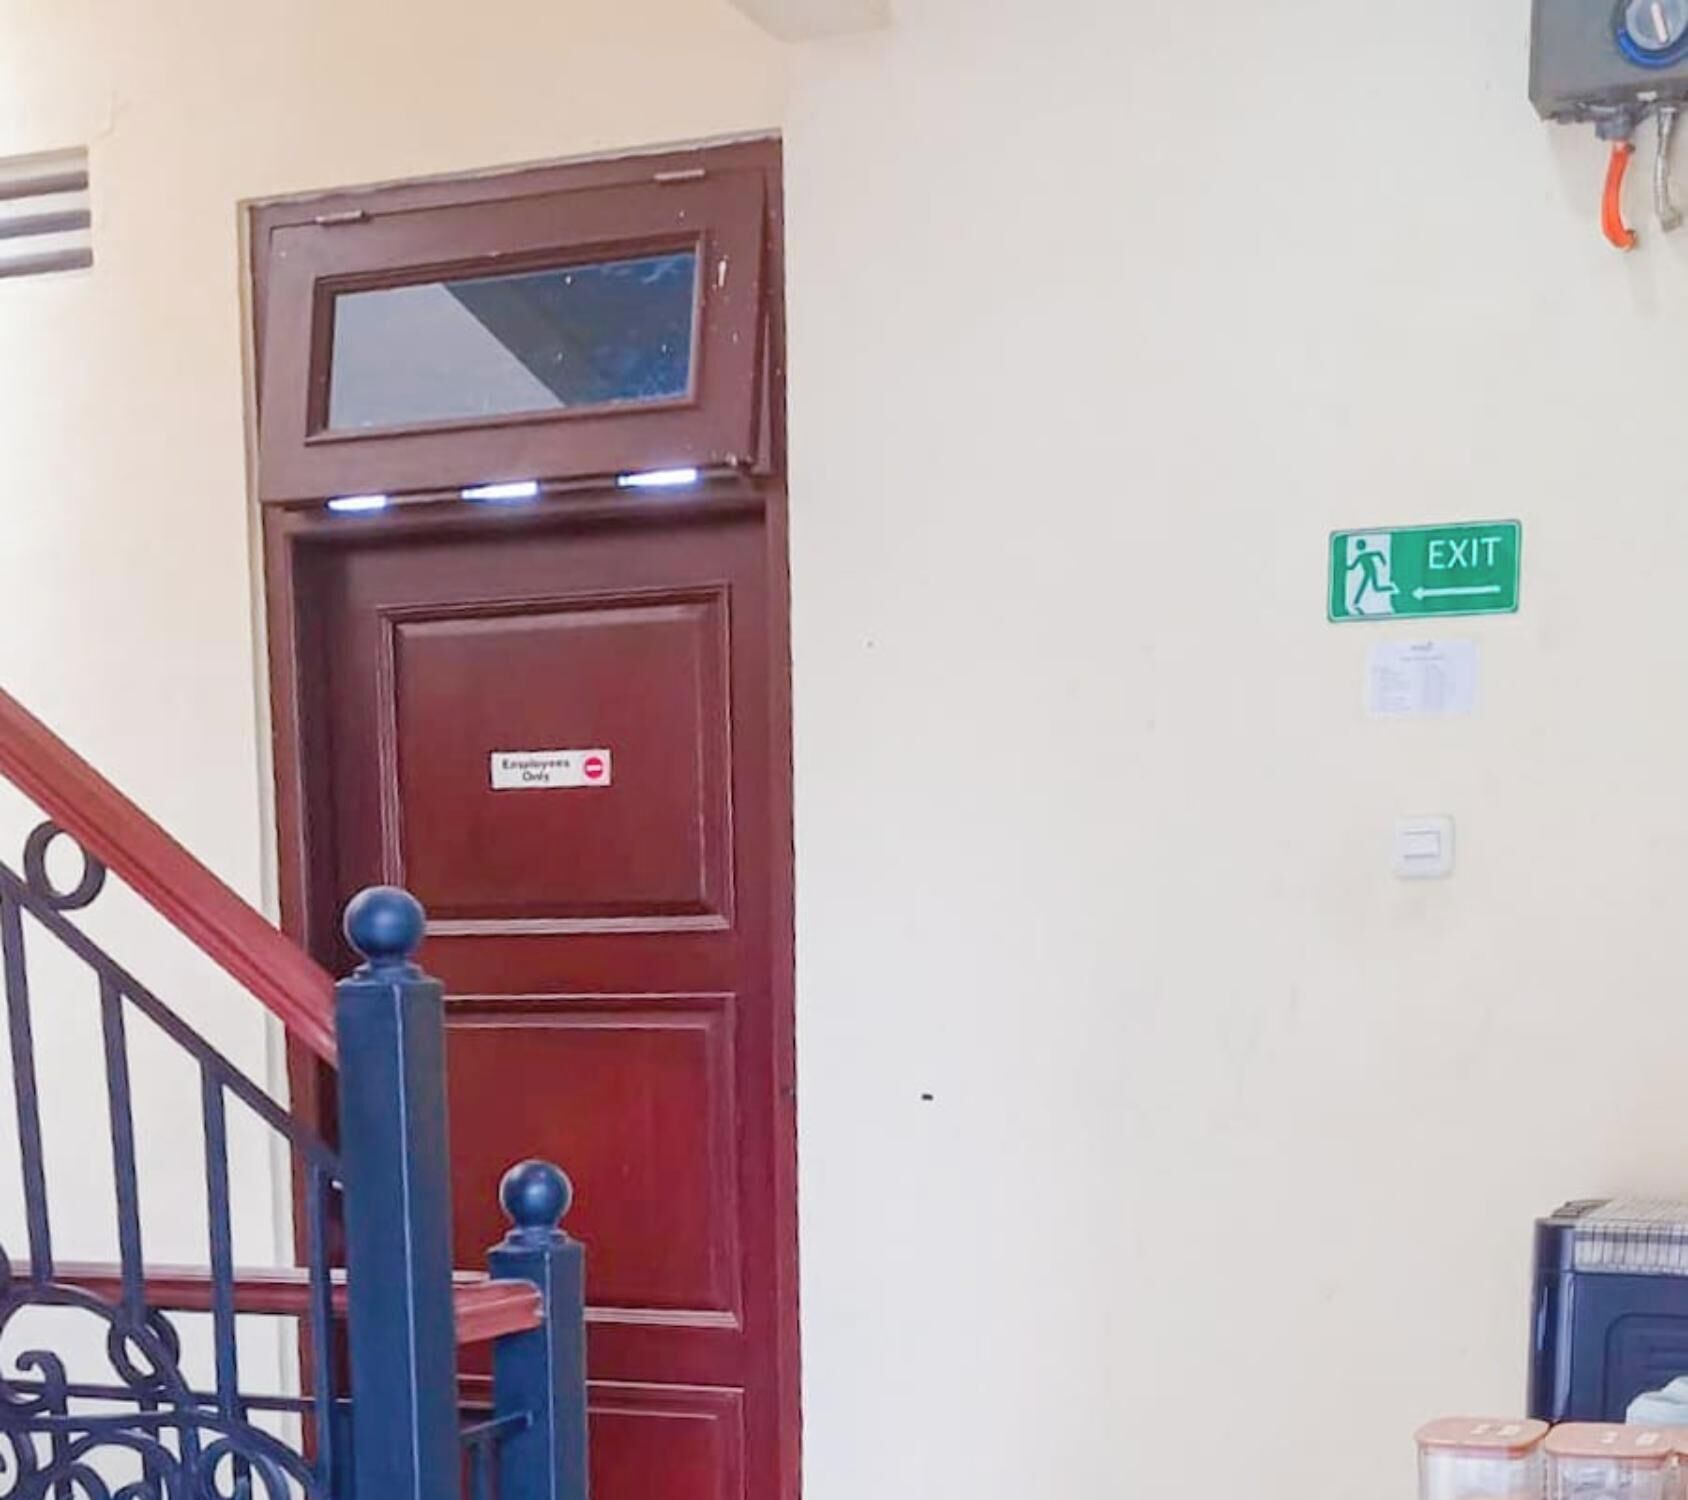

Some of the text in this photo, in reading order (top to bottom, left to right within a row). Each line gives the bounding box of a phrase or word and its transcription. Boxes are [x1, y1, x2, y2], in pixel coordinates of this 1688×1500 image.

[1428, 537, 1502, 569] EXIT
[502, 759, 570, 770] Employees
[522, 771, 550, 782] Only
